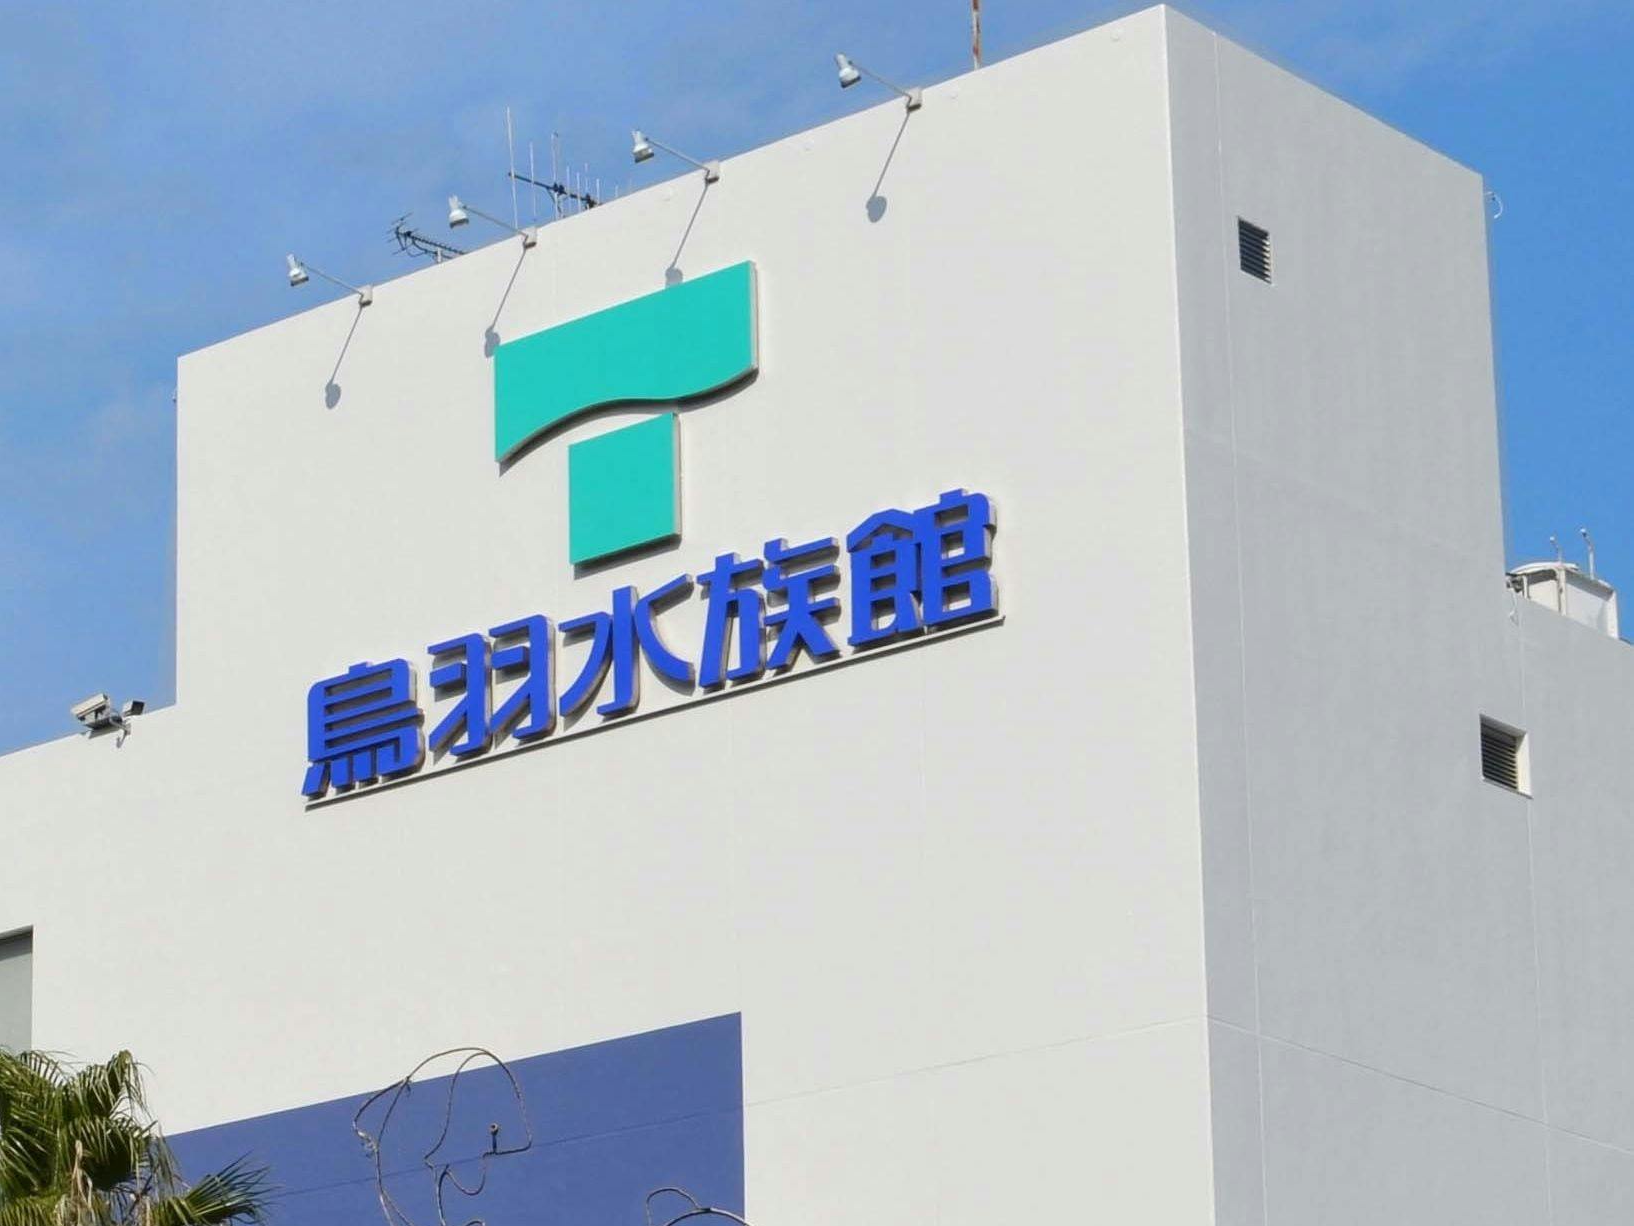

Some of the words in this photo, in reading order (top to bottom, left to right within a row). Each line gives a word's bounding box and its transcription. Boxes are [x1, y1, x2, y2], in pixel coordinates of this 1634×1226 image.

[301, 488, 999, 798] 鳥羽水族館
